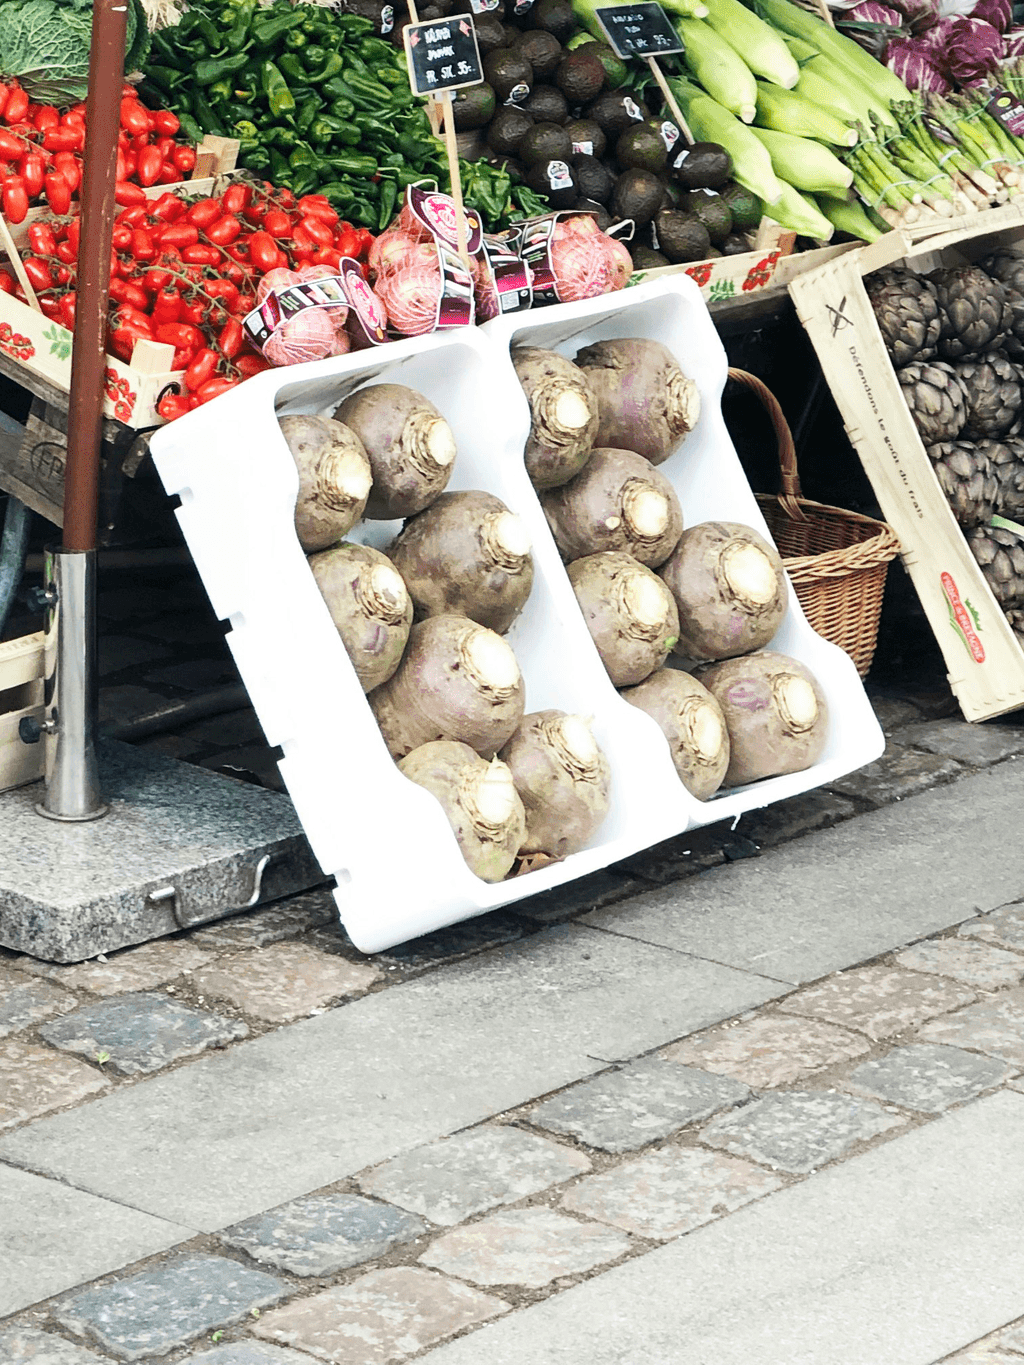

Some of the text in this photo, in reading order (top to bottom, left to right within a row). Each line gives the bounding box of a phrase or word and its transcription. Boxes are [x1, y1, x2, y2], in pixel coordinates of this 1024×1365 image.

[848, 345, 924, 520] Défendons le goût du frais
